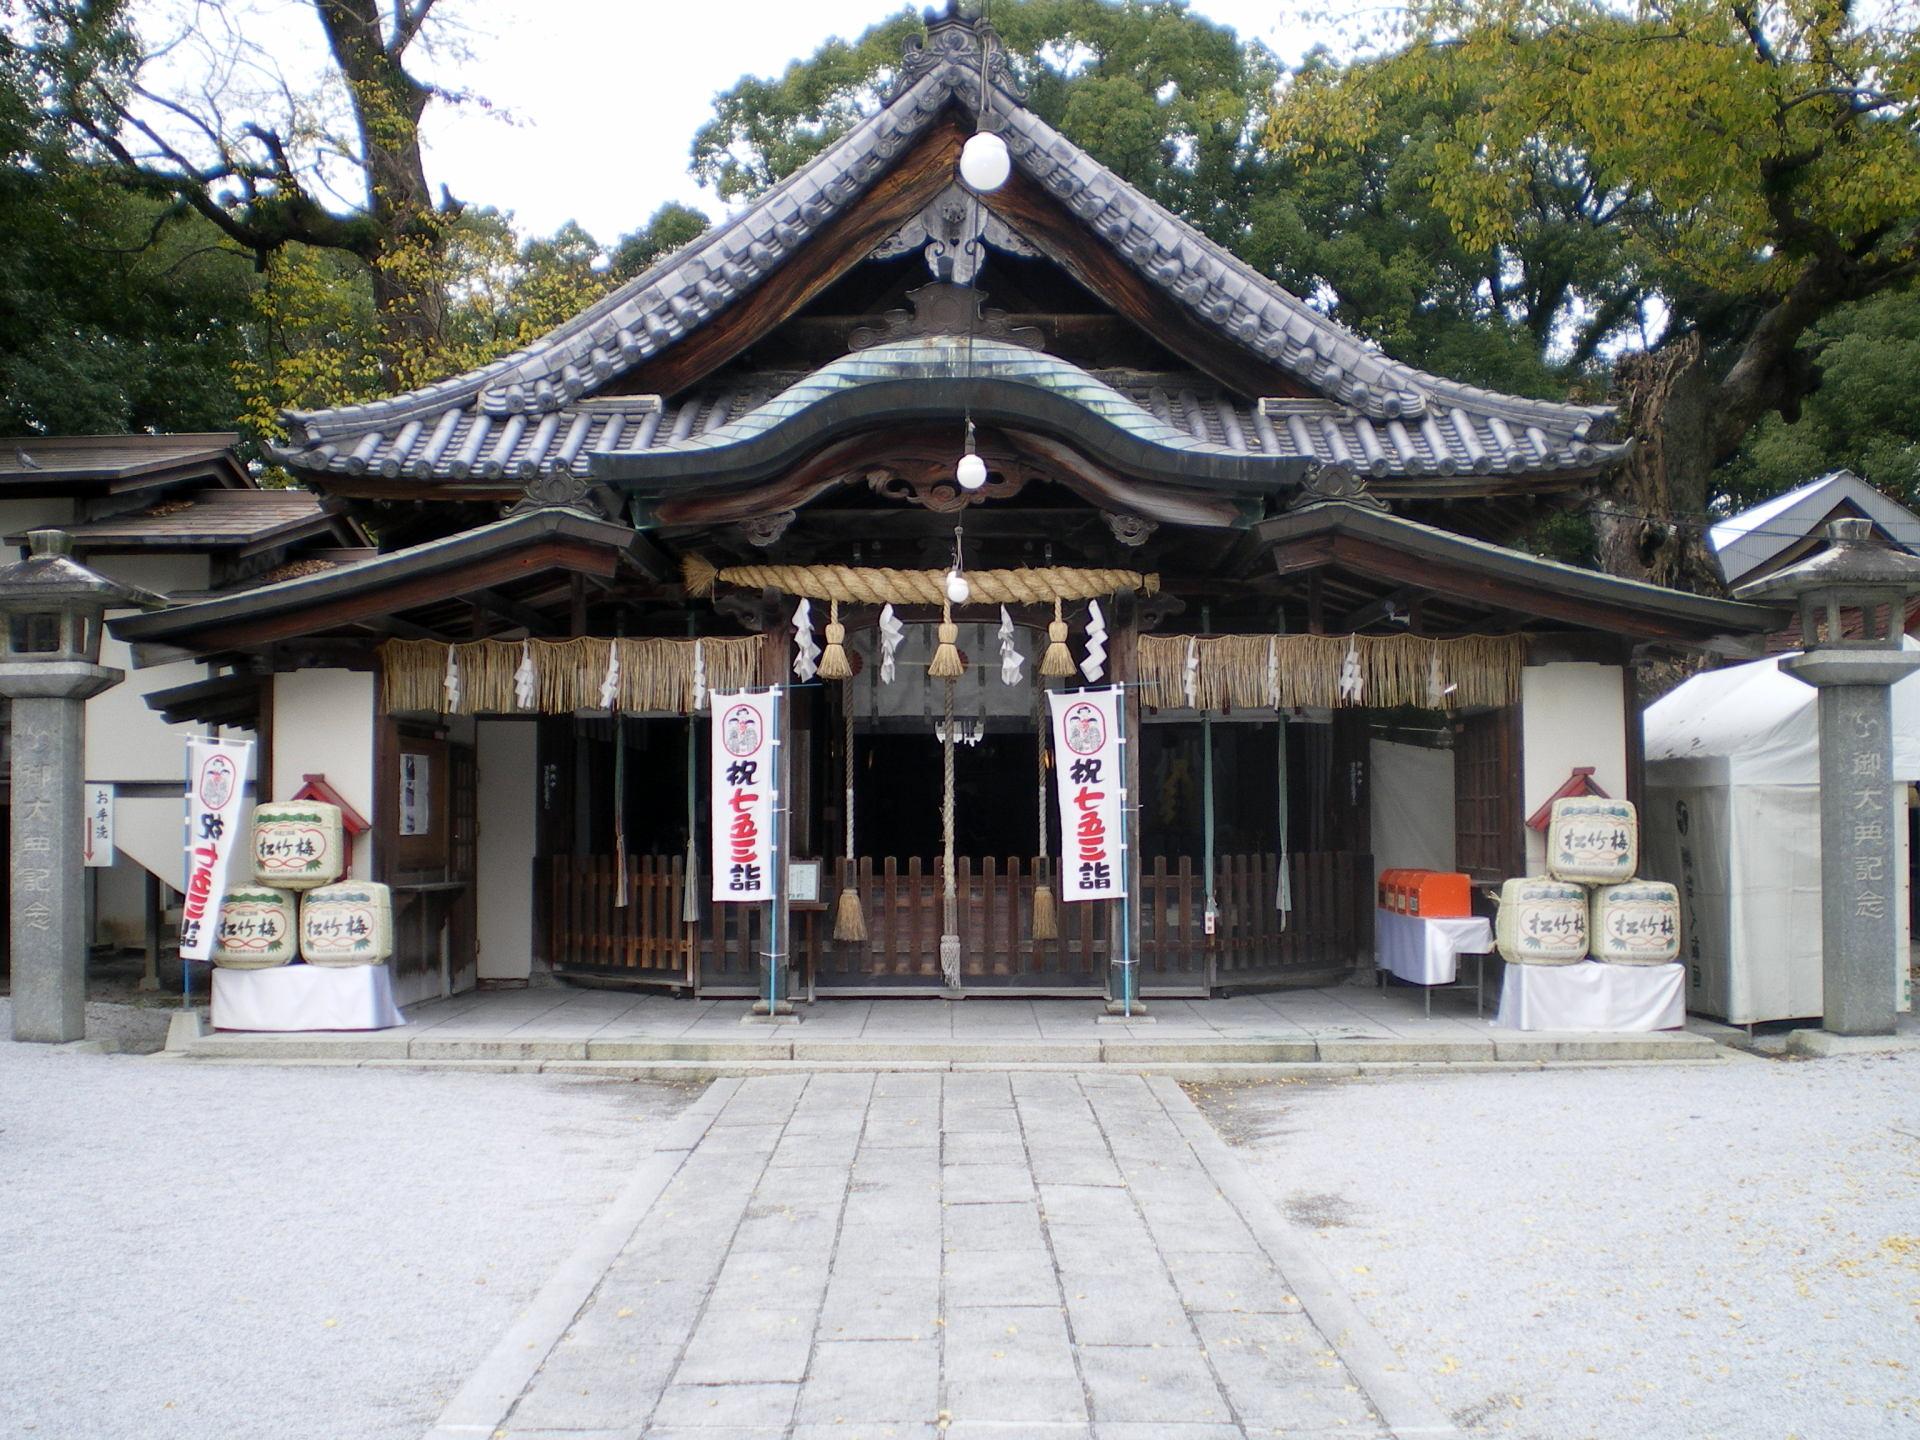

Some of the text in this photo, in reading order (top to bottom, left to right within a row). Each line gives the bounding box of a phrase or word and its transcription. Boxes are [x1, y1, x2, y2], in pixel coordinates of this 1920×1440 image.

[96, 790, 108, 840] お手洗
[726, 760, 761, 891] 祝七五三詣
[1069, 758, 1110, 890] 祝七五三詣
[1565, 828, 1628, 850] 松竹梅
[1852, 751, 1885, 918] 御大典記念
[259, 837, 316, 857] 松竹梅
[220, 917, 278, 937] 松竹梅
[307, 915, 368, 937] 松竹梅
[1529, 912, 1585, 934] 松竹梅
[1615, 914, 1675, 935] 松竹梅
